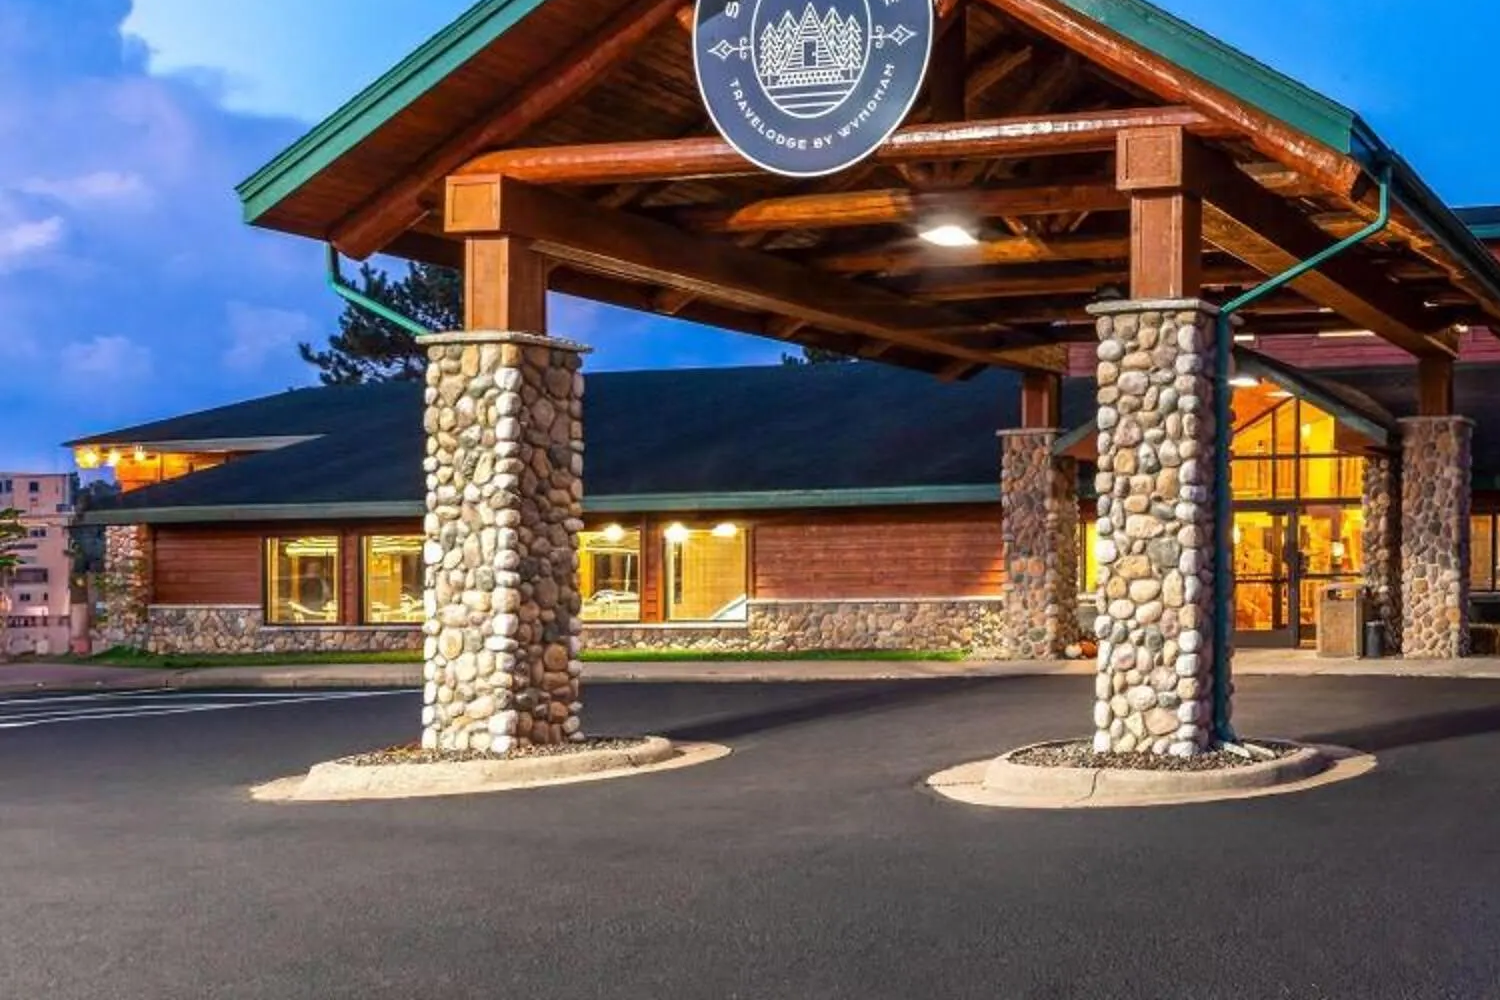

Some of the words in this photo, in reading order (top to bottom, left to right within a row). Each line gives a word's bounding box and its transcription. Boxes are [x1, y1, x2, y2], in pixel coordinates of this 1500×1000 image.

[728, 78, 807, 150] TRAVELODGE
[813, 134, 834, 149] BY
[837, 63, 895, 137] WYNDHAM
